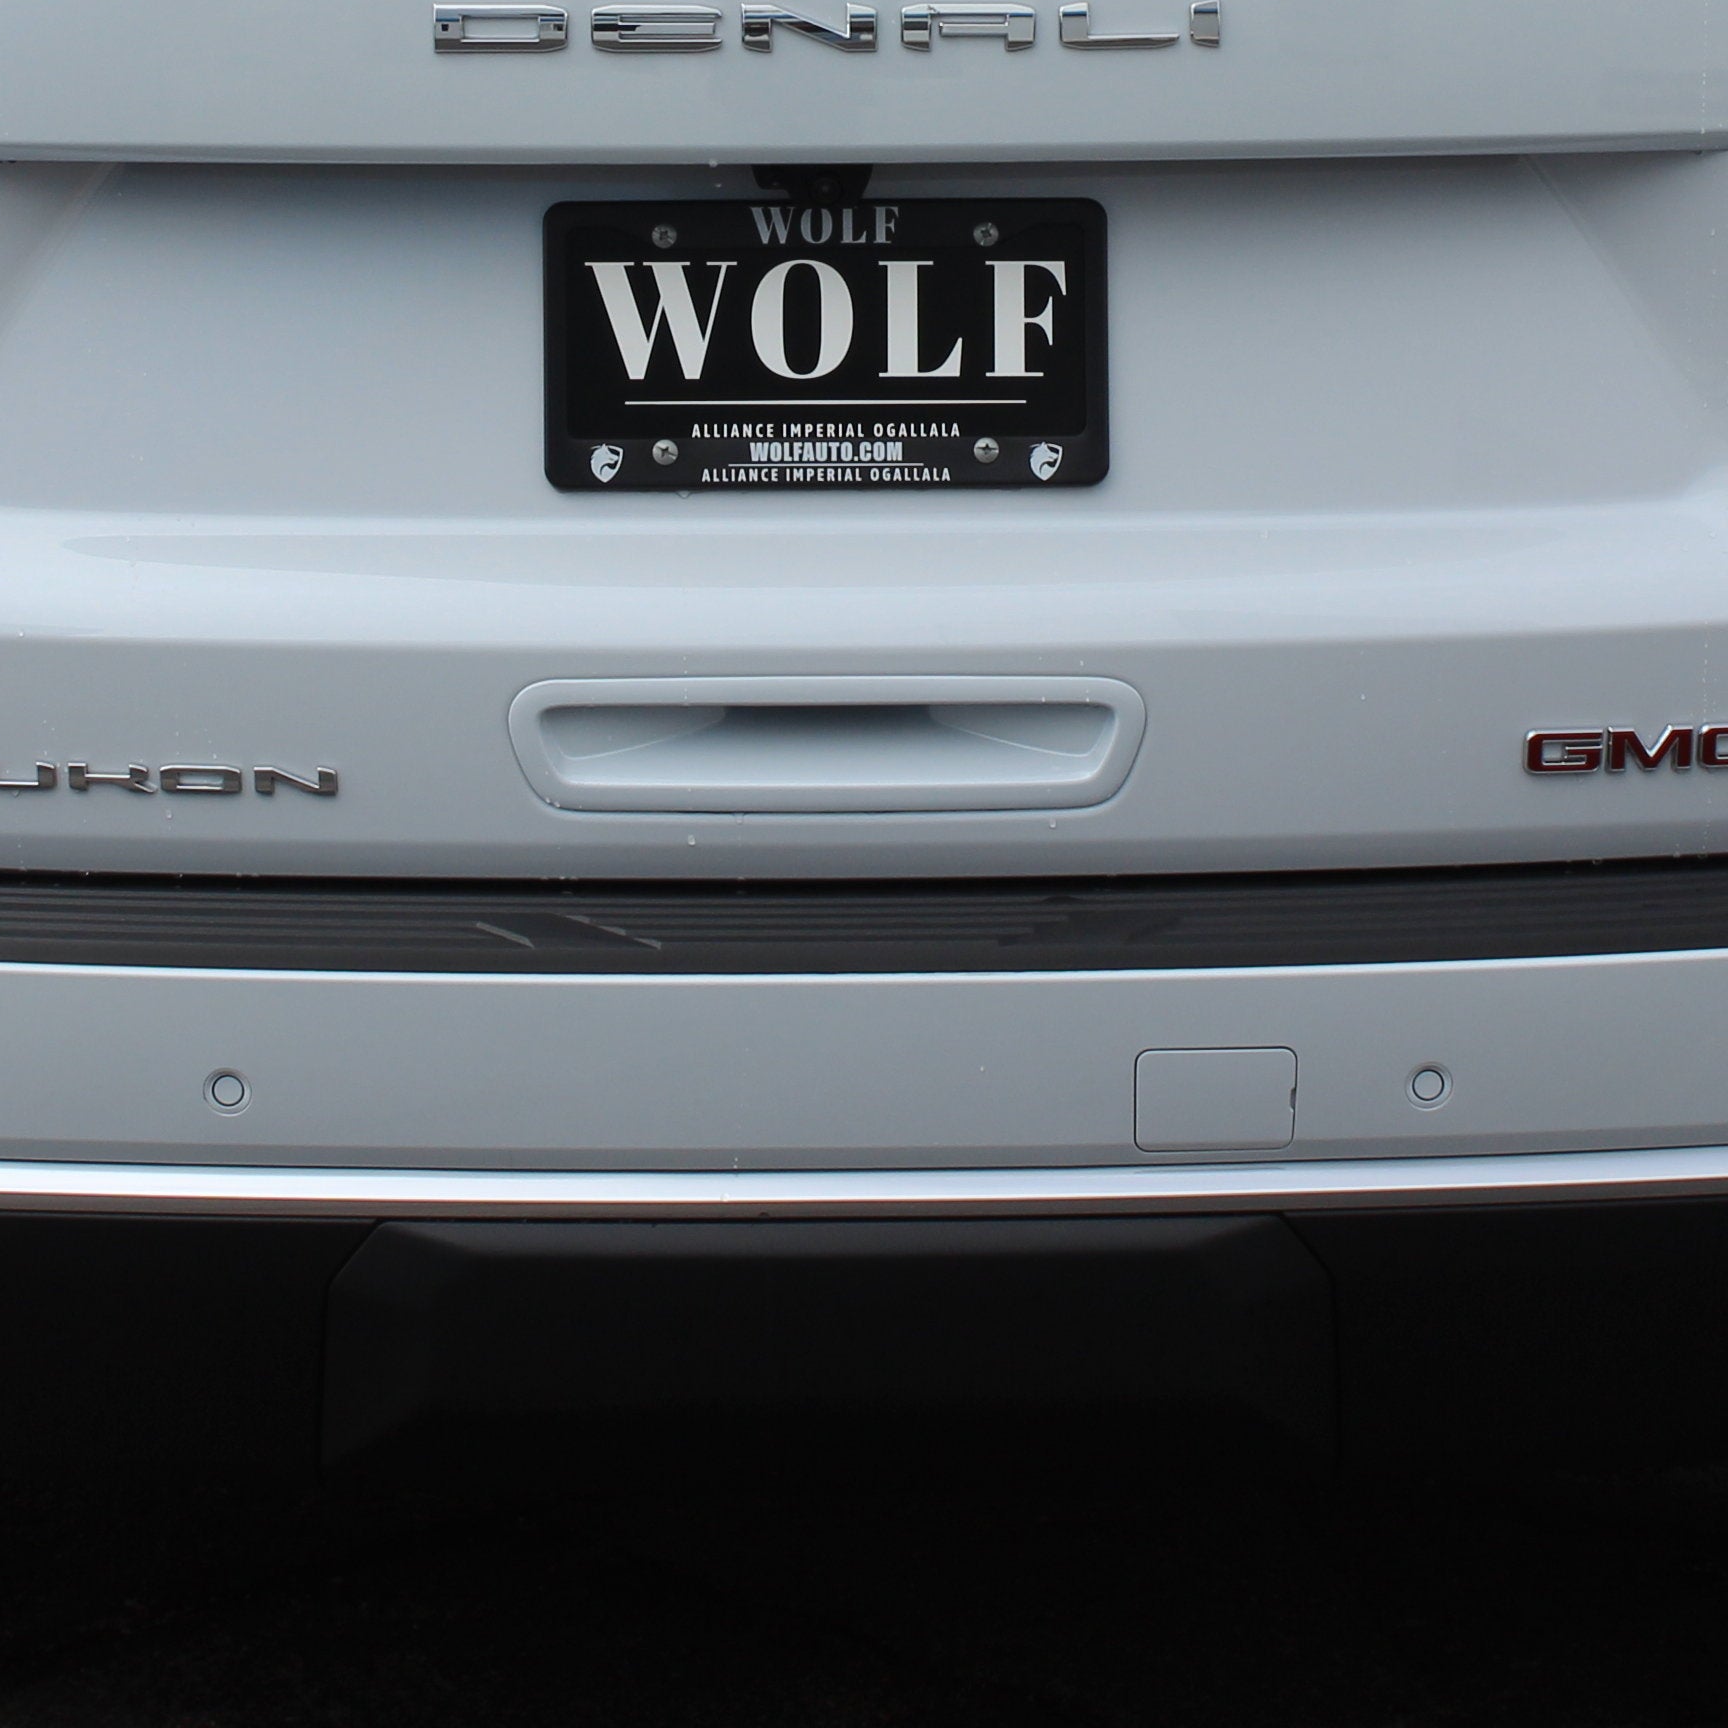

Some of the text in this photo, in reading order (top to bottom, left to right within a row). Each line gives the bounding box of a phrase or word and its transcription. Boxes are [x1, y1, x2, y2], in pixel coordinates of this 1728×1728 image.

[749, 205, 900, 245] WOLF
[584, 258, 1068, 381] WOLF
[691, 422, 961, 439] ALLIANCE IMPERIAL OGALLALA
[749, 441, 904, 463] WOLFAUTO.COM
[701, 468, 952, 483] ALLIANCE IMPERIAL OGALLALA
